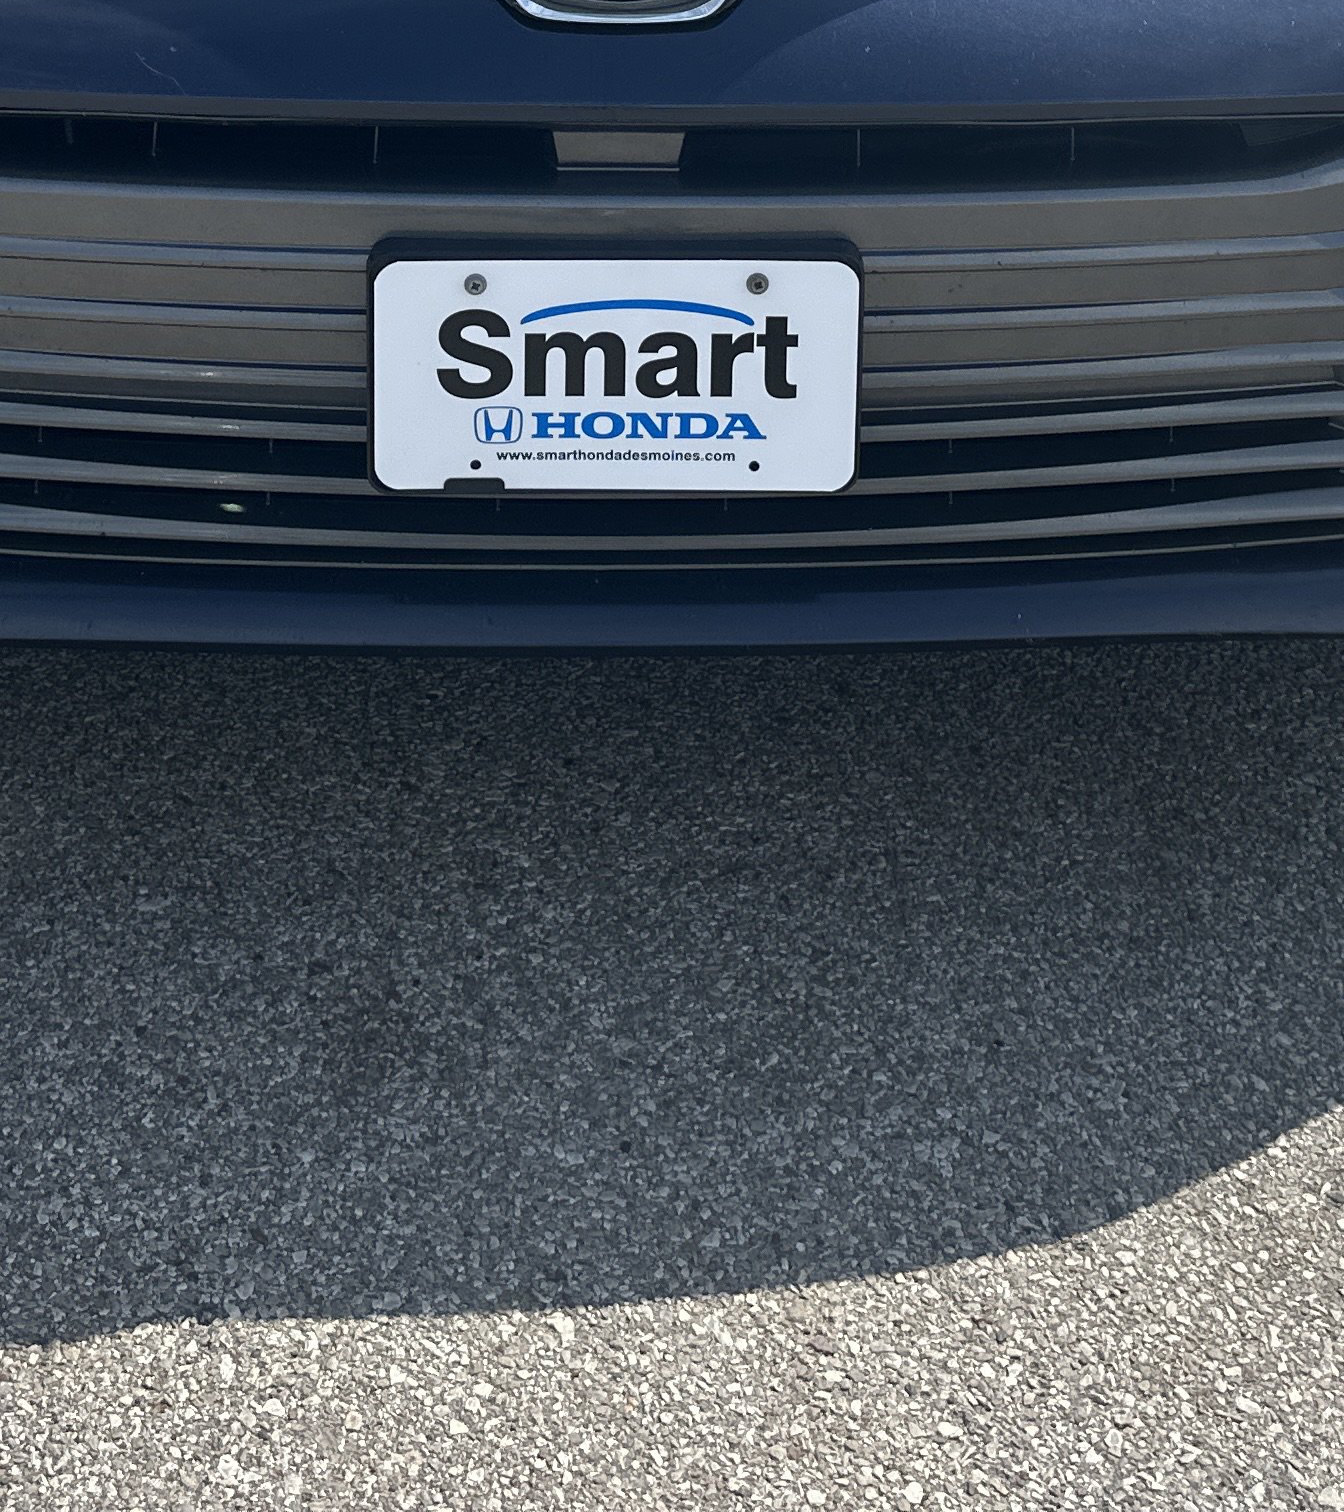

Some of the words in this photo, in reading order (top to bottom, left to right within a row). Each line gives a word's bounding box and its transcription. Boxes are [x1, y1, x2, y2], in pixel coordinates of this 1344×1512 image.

[436, 308, 799, 399] Smart
[531, 411, 767, 440] HONDA
[495, 449, 737, 462] www.smarthondadesmoines.com
